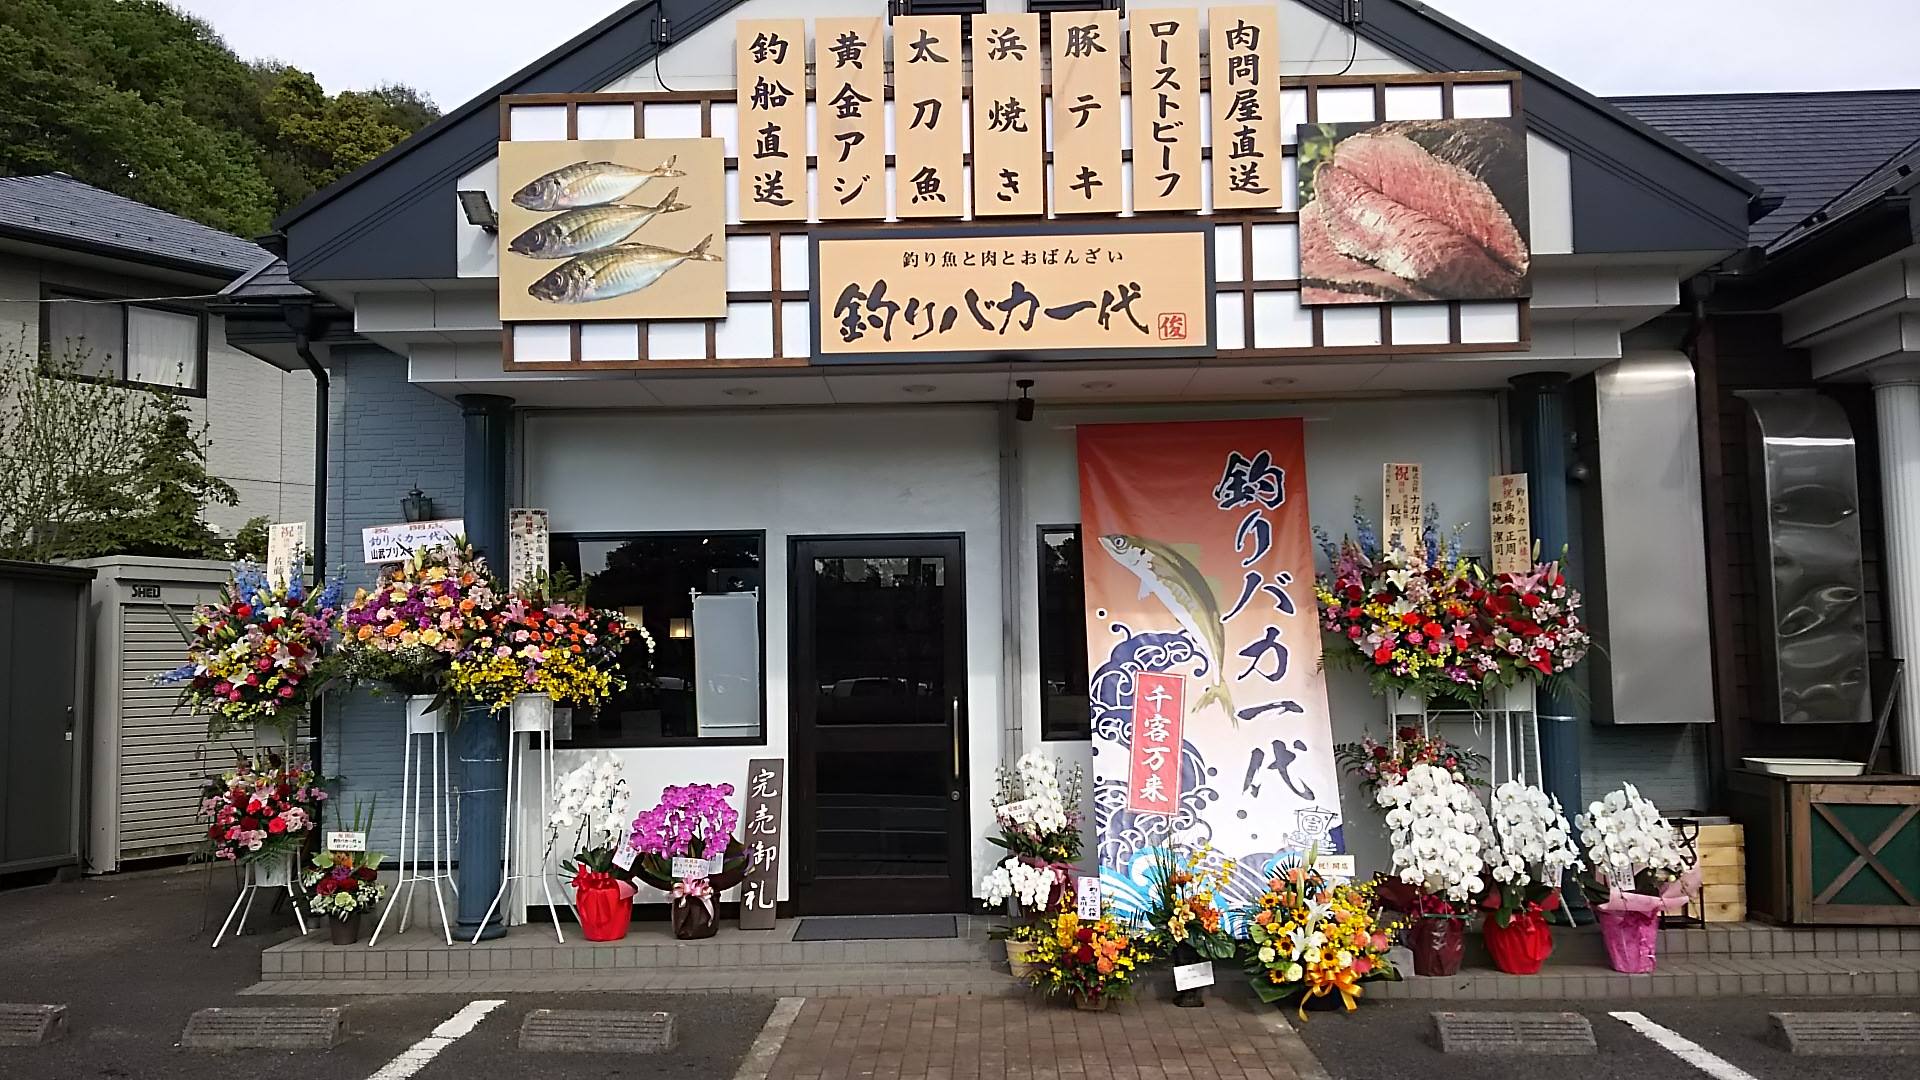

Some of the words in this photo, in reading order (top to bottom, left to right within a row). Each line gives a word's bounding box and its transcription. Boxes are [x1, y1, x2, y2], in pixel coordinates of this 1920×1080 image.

[748, 31, 795, 207] 釣船直送
[827, 30, 873, 207] 黄金アジ
[906, 28, 949, 204] 太刀魚
[986, 27, 1029, 202] 浜焼き
[1064, 24, 1107, 201] 豚テキ
[1148, 20, 1182, 199] ローストビーフ
[1224, 18, 1269, 196] 肉問屋直送
[833, 279, 1150, 343] 釣りバカ一代
[902, 247, 1125, 269] 釣り魚と肉とおばんざい
[1159, 313, 1186, 340] 俊
[1394, 465, 1409, 481] 祝
[132, 584, 160, 598] SHED
[1212, 449, 1316, 802] 釣りバカ一代
[1138, 684, 1174, 805] 千客万来
[744, 768, 777, 911] 完売御礼
